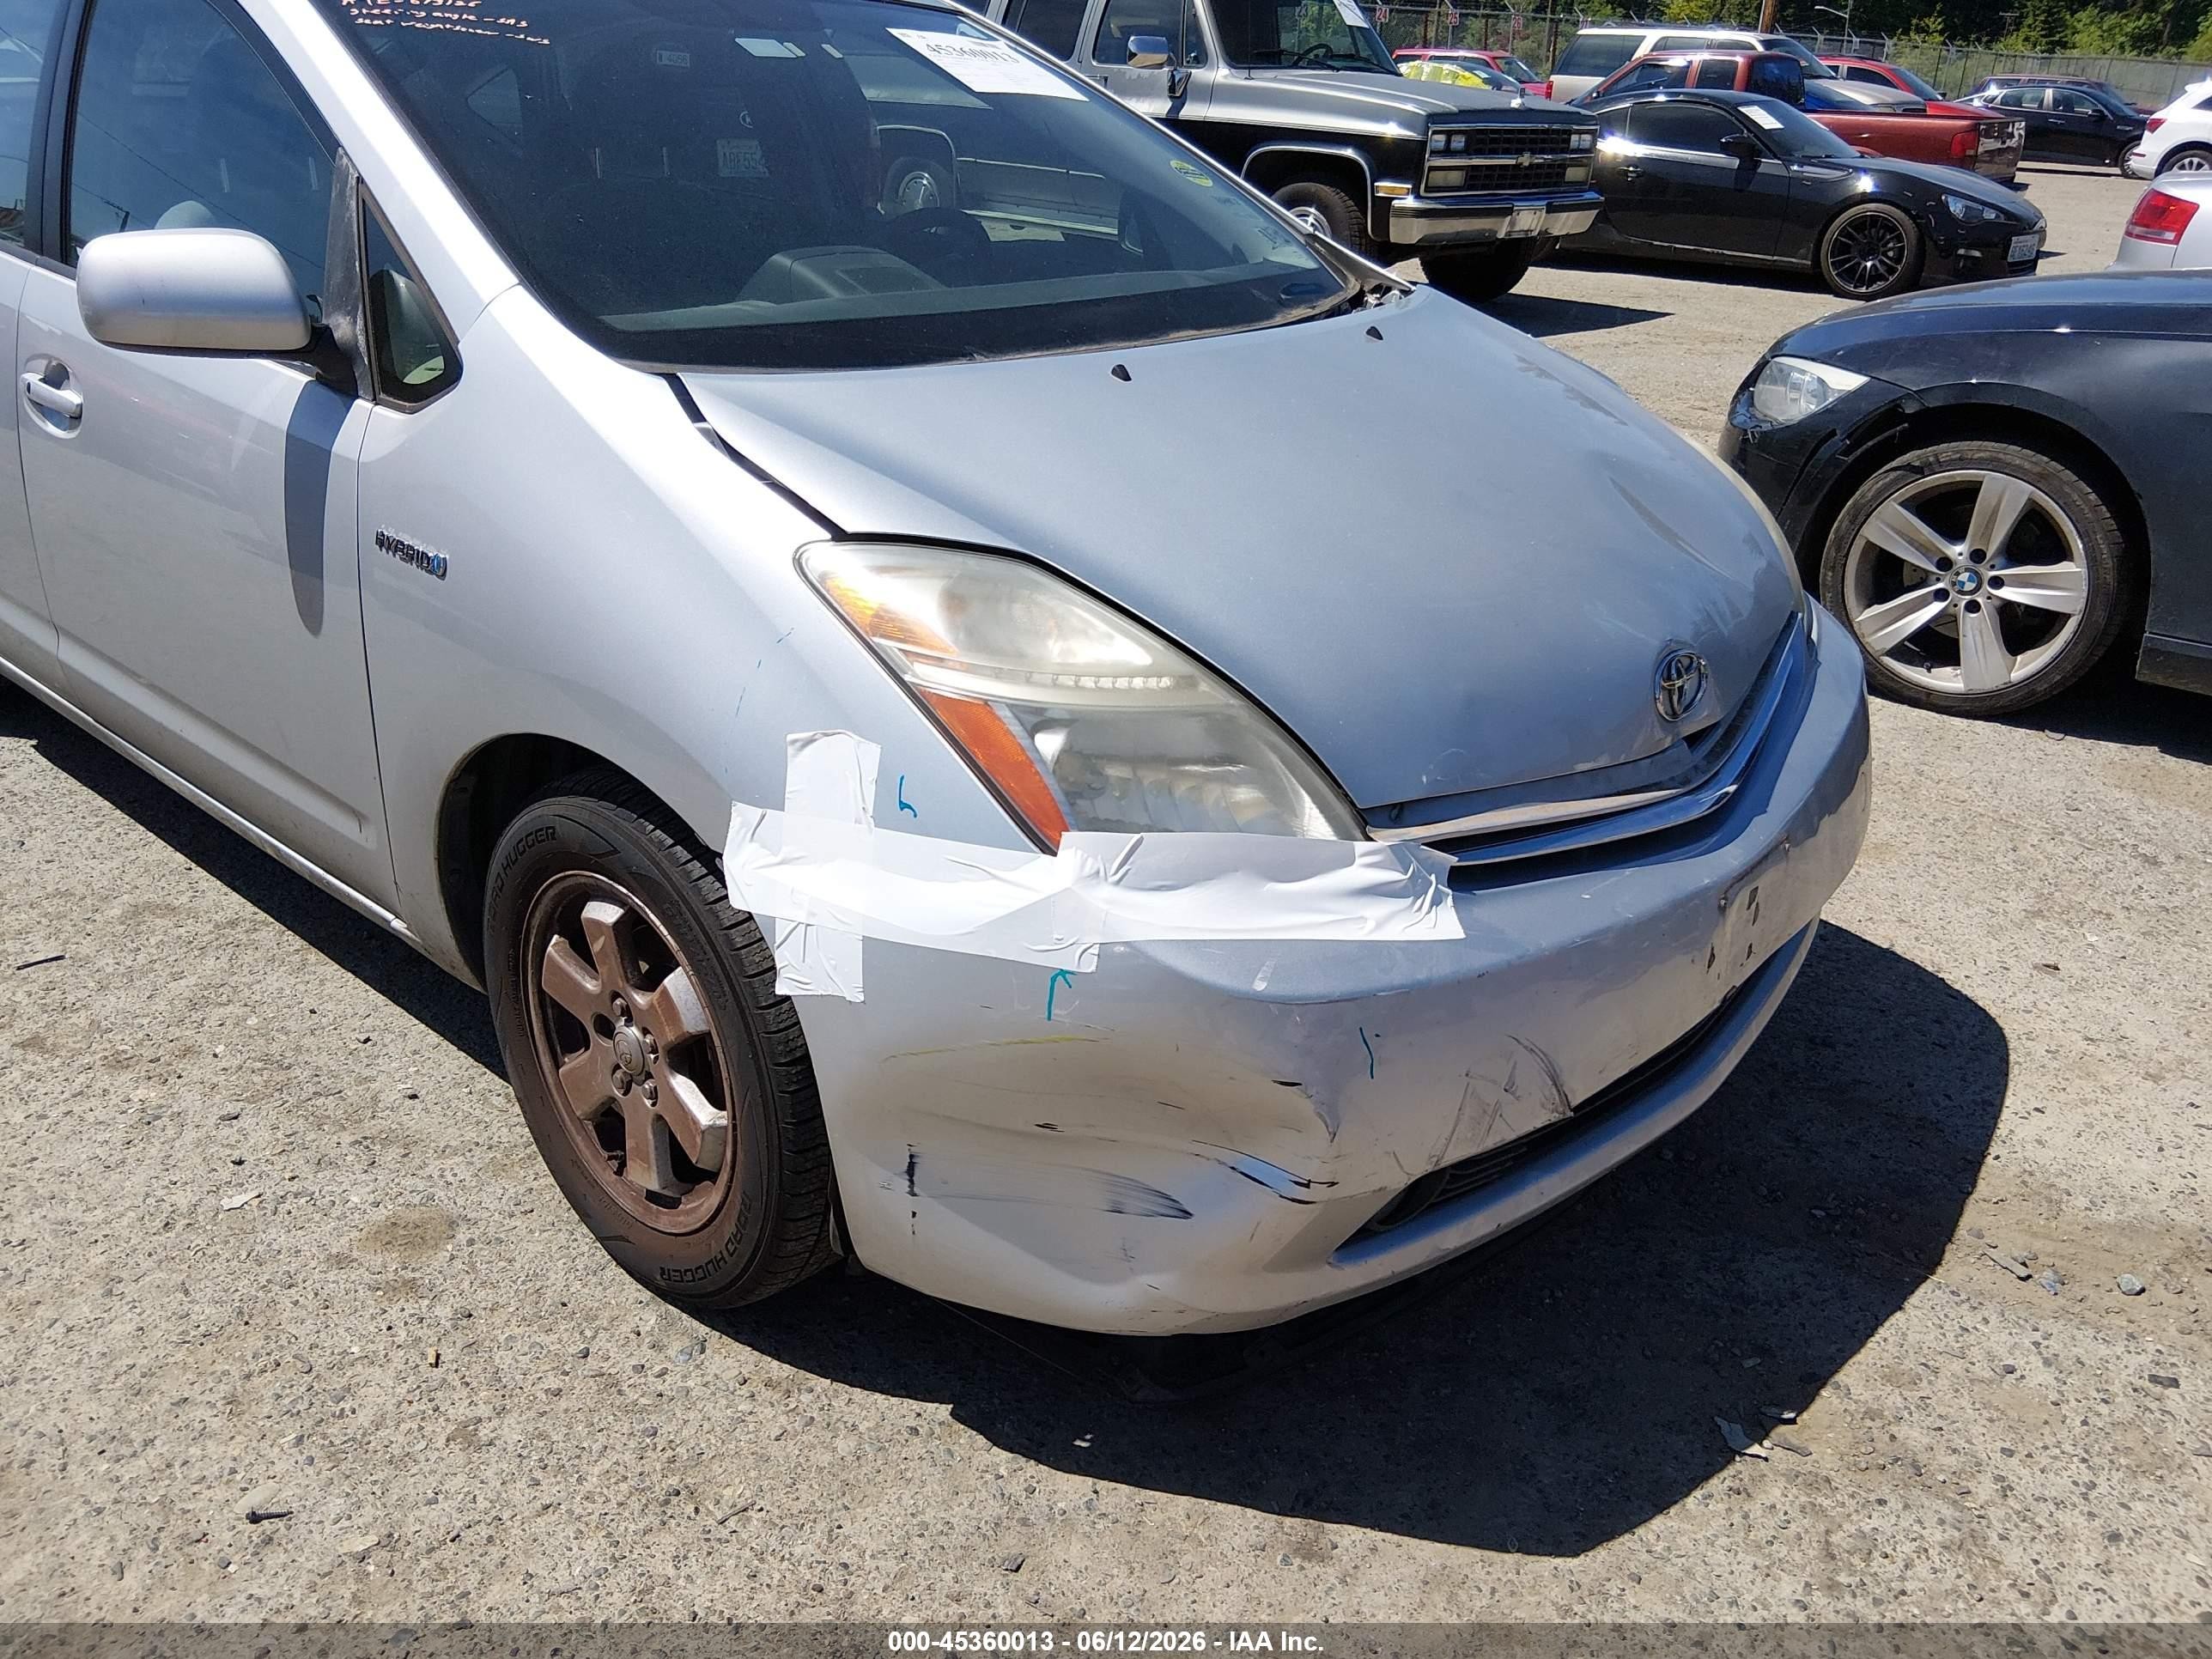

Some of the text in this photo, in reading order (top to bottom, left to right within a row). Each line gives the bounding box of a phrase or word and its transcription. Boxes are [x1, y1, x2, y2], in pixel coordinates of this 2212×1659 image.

[1377, 7, 1388, 21] 24
[1449, 12, 1458, 25] 25
[1512, 17, 1522, 29] 26
[501, 825, 557, 877] HUGGER
[659, 1249, 728, 1284] HUGGER
